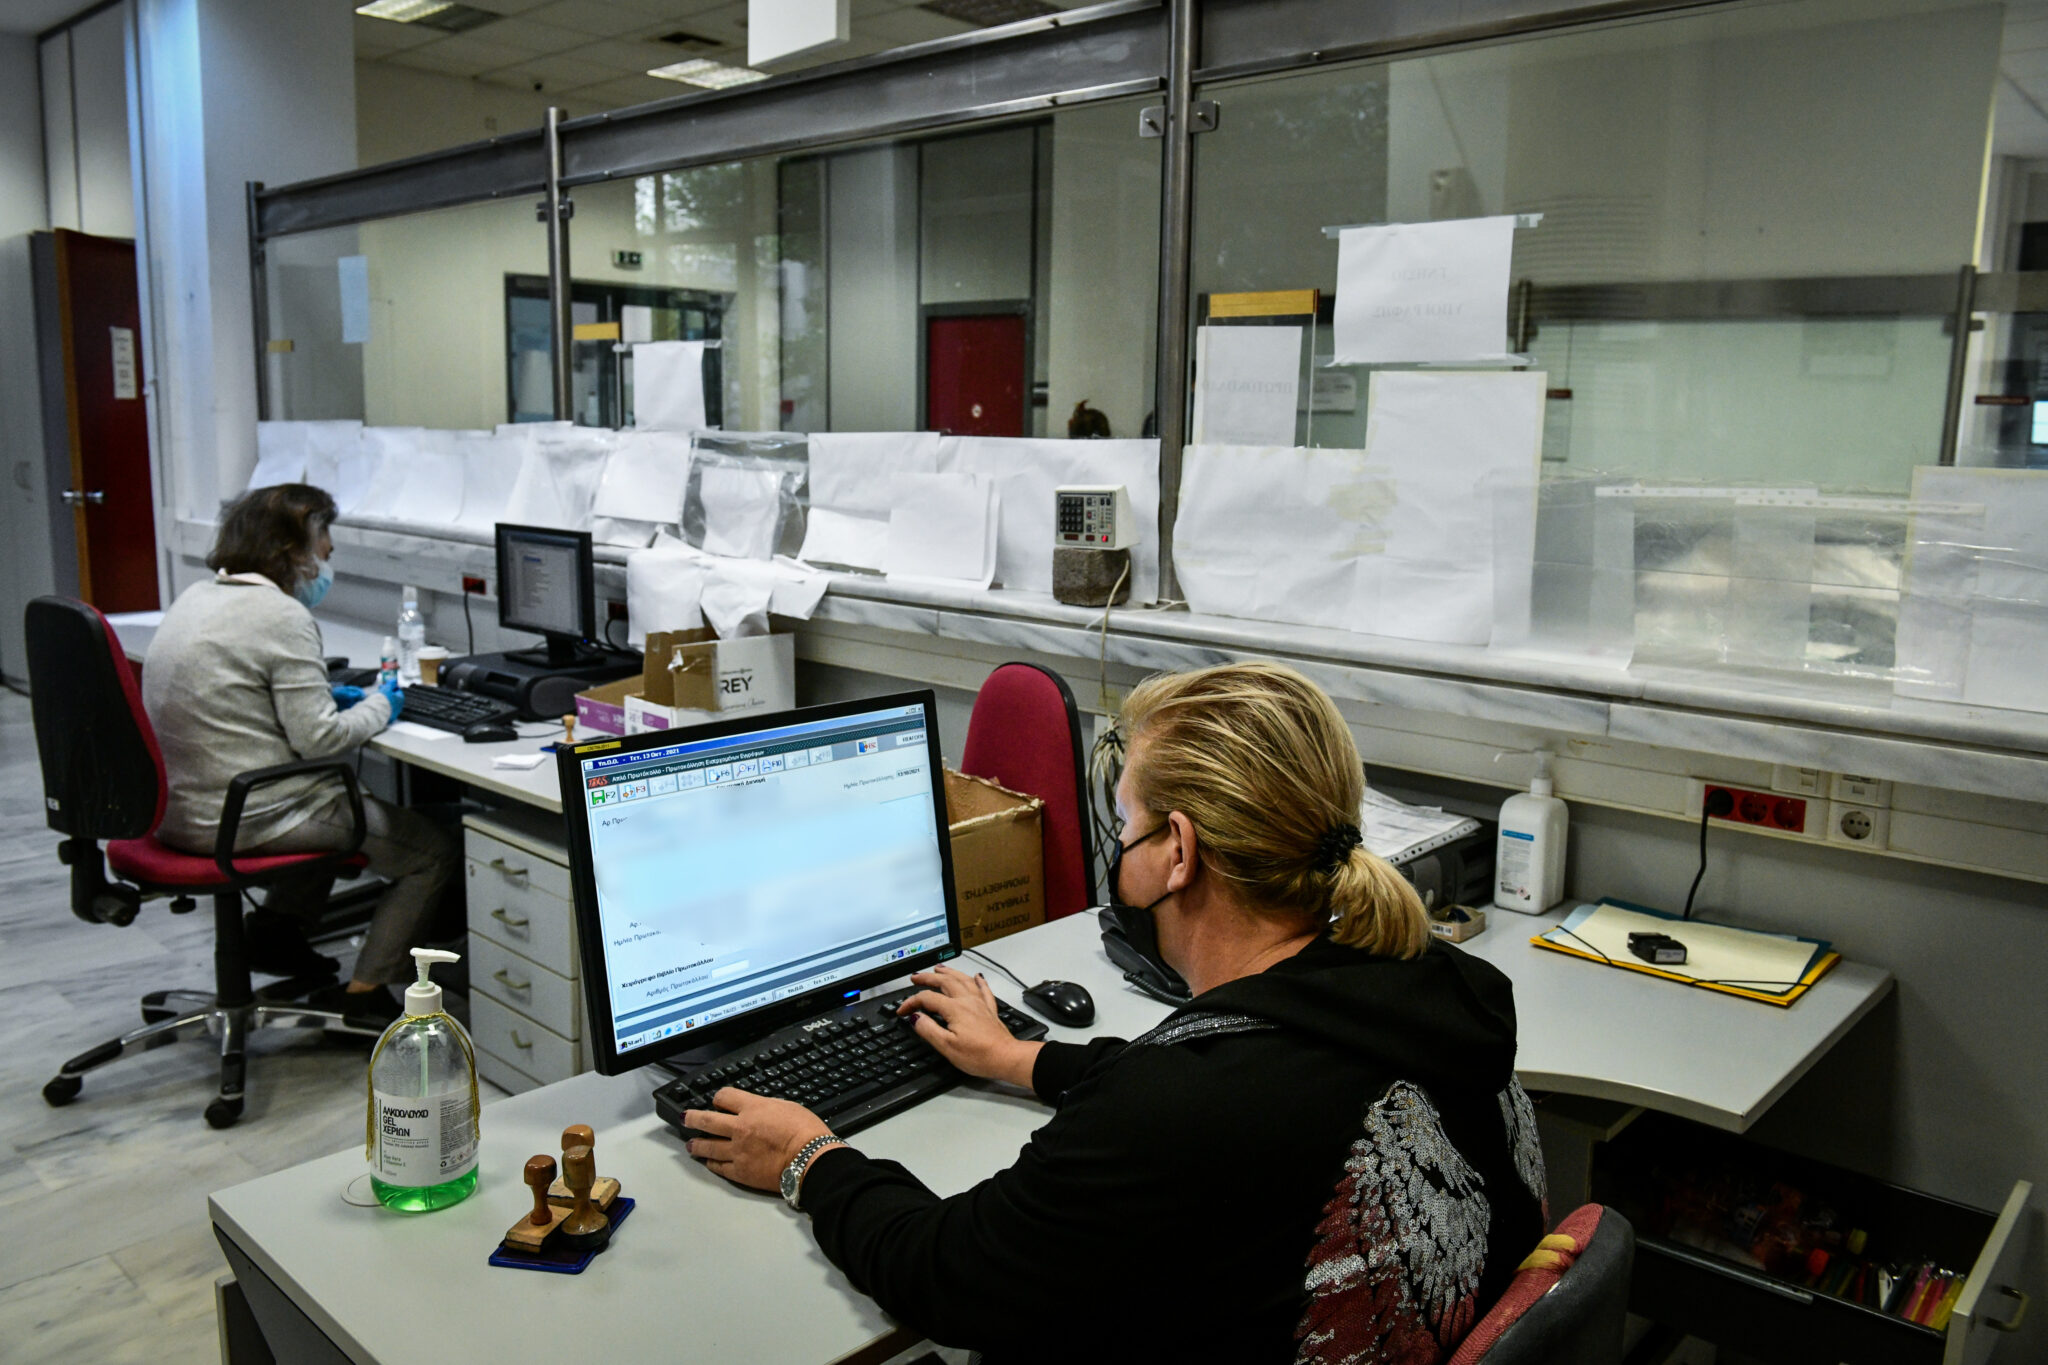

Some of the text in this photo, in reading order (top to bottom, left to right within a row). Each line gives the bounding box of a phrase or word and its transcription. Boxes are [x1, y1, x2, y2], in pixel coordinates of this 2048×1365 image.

[665, 748, 680, 756] 2021
[747, 764, 756, 772] F7
[771, 758, 782, 768] F10
[635, 785, 646, 793] F3
[605, 790, 616, 799] F2
[802, 1018, 833, 1032] DELL
[627, 1036, 643, 1047] Start
[383, 1115, 397, 1127] GEL
[383, 1125, 410, 1137] ΧΕΡΙΩΝ
